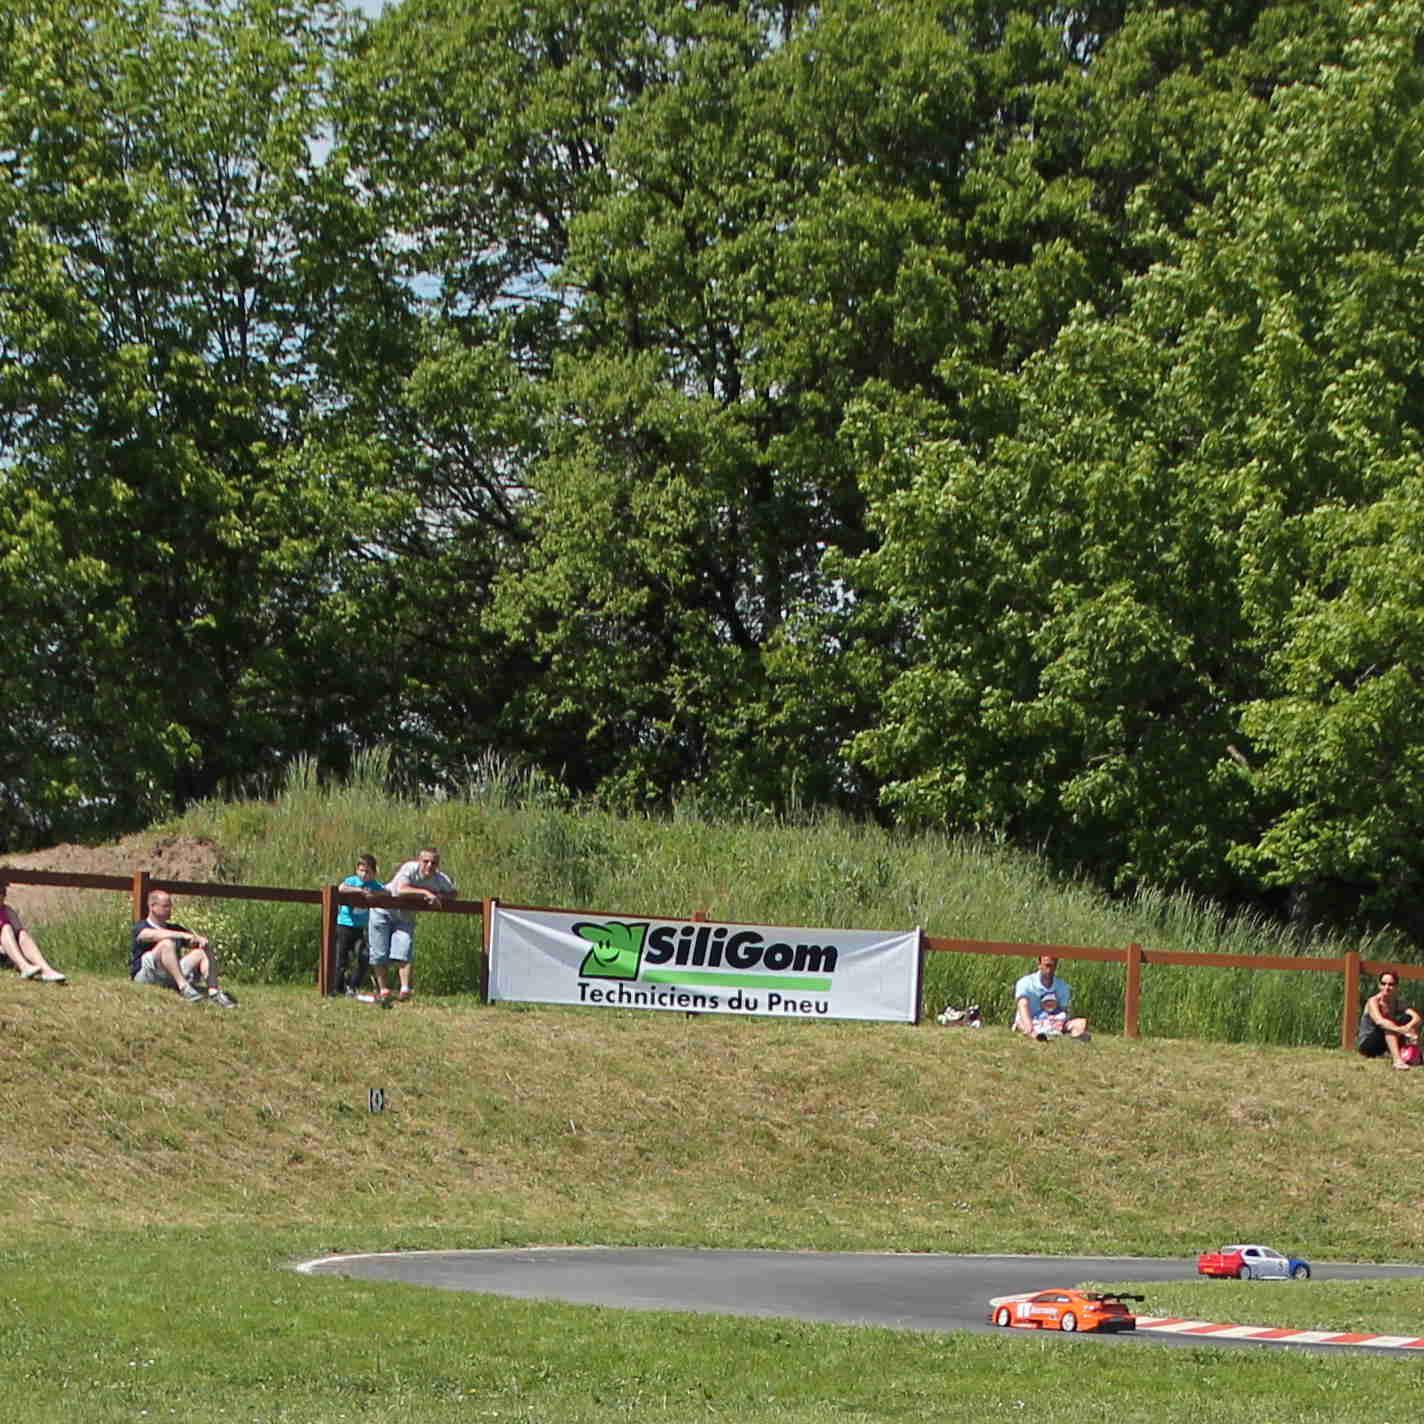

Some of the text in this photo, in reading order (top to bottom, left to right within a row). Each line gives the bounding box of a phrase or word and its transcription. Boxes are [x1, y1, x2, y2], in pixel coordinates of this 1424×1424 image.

[644, 926, 838, 972] SiliGom
[577, 982, 828, 1014] Techniciens du Pneu
